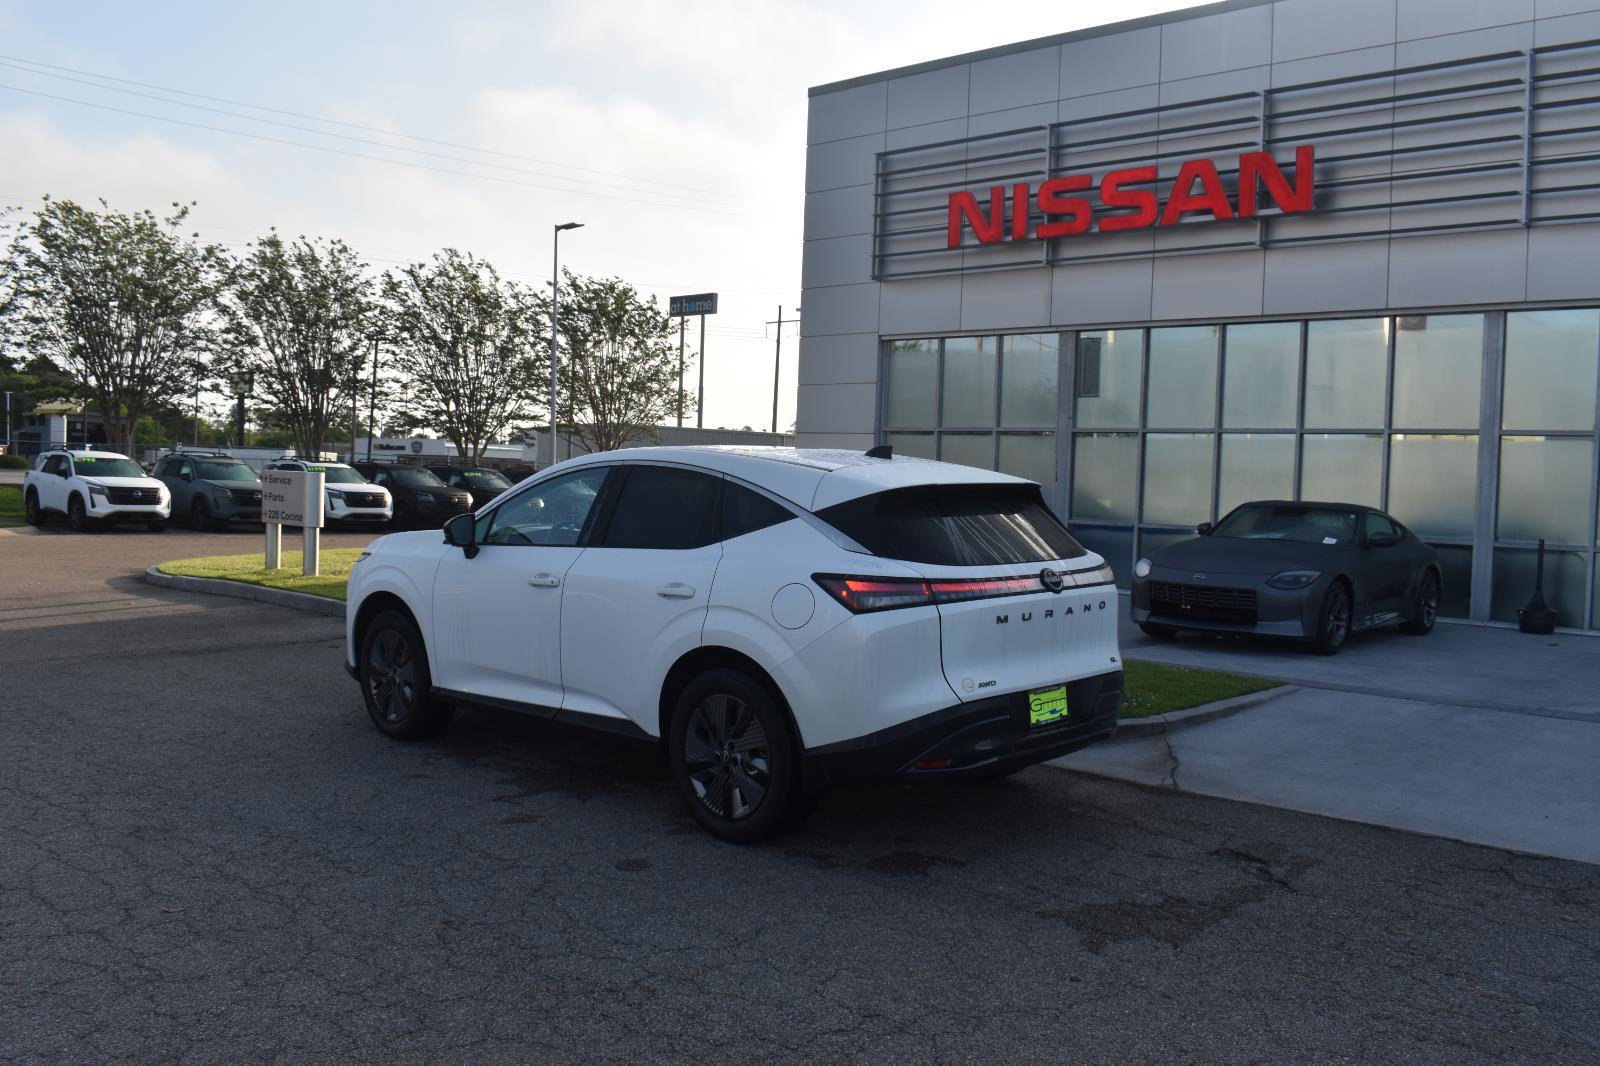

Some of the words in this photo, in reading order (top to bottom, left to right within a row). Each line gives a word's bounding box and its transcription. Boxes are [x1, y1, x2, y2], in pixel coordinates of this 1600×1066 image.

[948, 145, 1314, 248] NISSAN
[671, 301, 680, 313] at
[269, 474, 292, 485] Service
[268, 492, 285, 502] Parts
[996, 600, 1106, 625] MURANO
[978, 679, 997, 689] AWD
